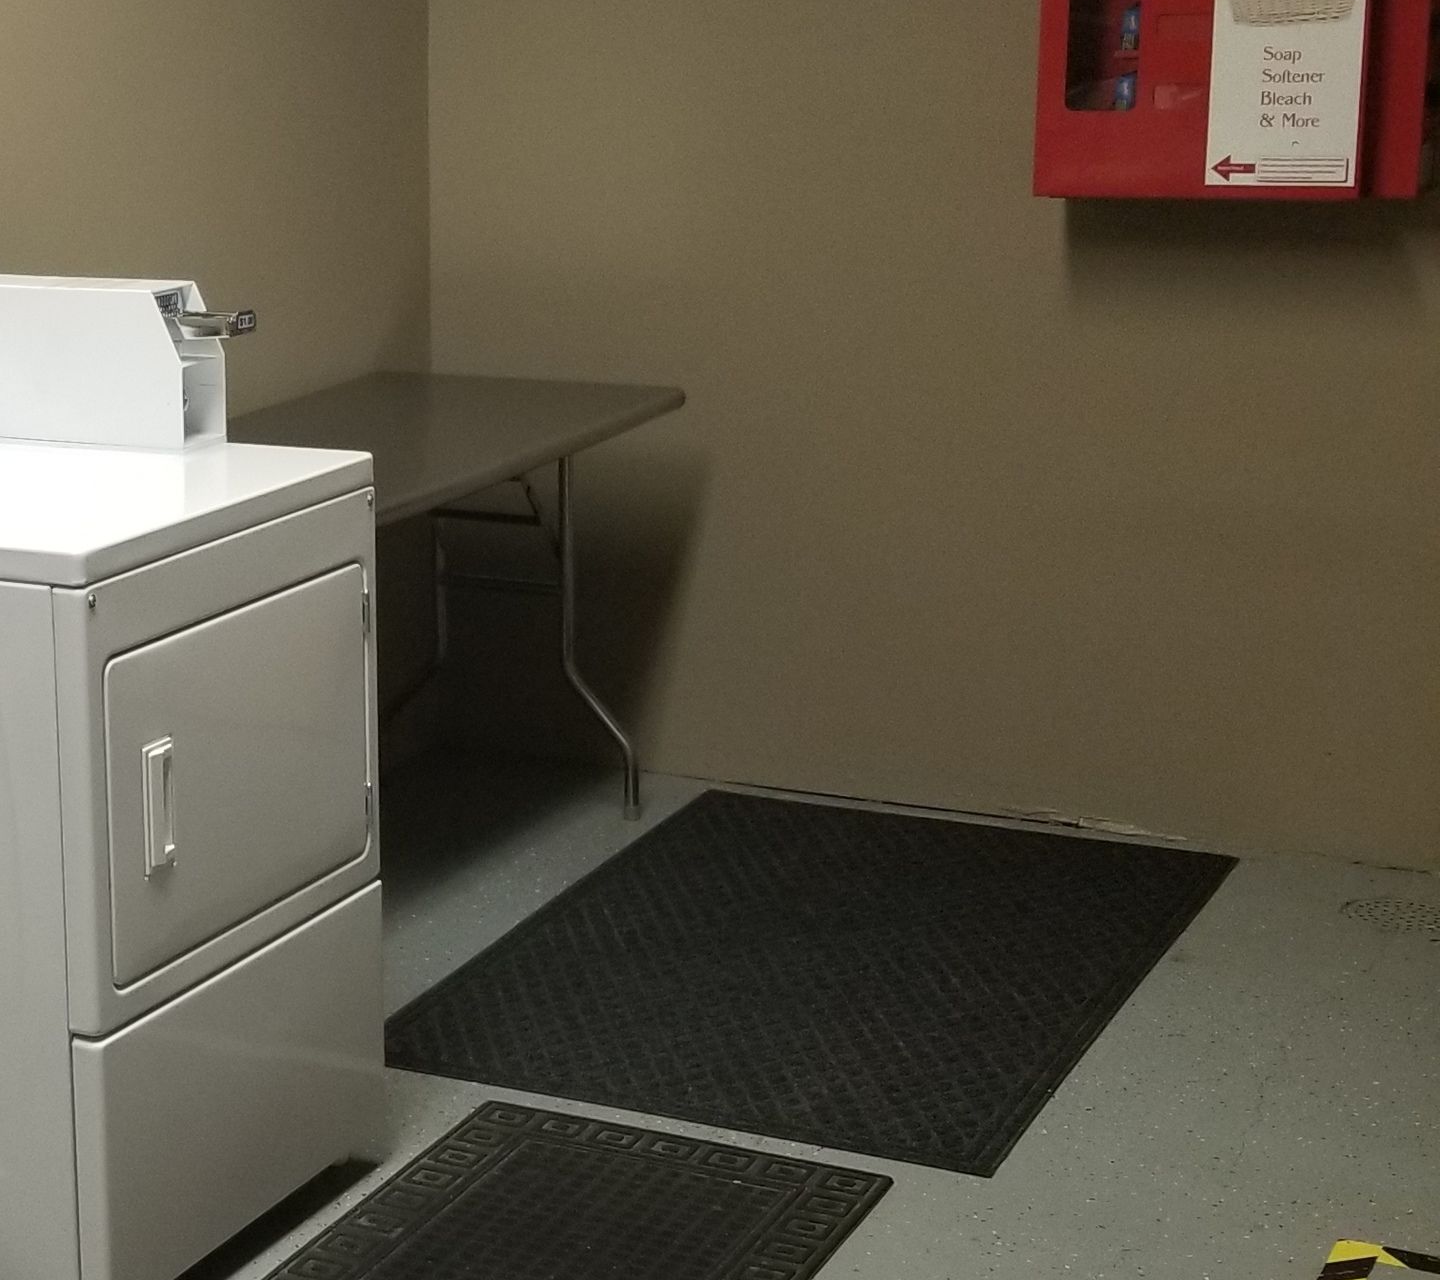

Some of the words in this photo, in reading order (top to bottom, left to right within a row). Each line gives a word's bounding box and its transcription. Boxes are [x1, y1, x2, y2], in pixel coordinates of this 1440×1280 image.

[1263, 46, 1302, 64] Soap
[1262, 69, 1325, 84] Softener
[1260, 91, 1312, 105] Bleach
[1260, 113, 1275, 128] &
[1282, 113, 1320, 128] More
